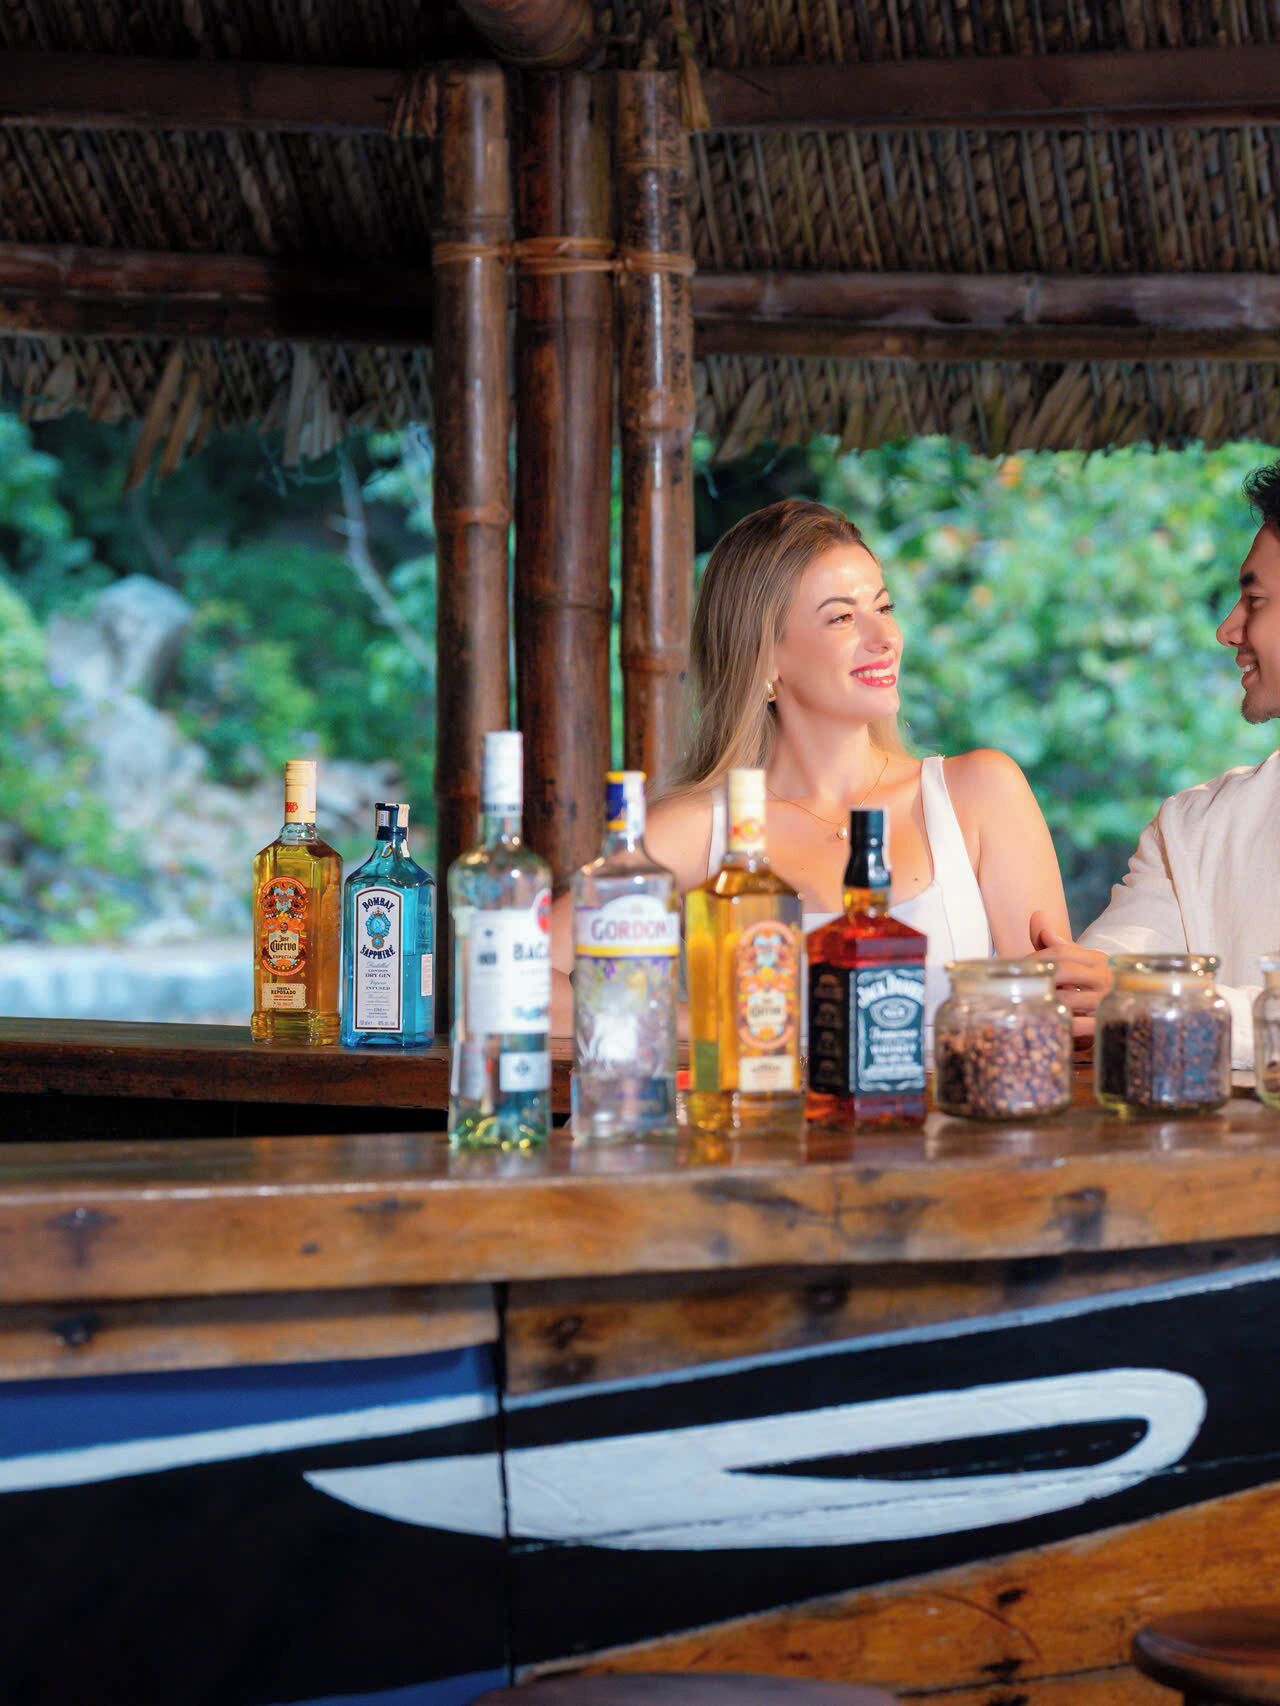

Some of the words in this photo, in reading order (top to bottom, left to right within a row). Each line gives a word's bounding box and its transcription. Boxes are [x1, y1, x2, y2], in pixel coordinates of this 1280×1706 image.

[362, 896, 395, 912] BOMBAY
[270, 940, 297, 952] Cuervo
[360, 944, 396, 959] SAPPHIRE
[513, 943, 549, 961] BAC
